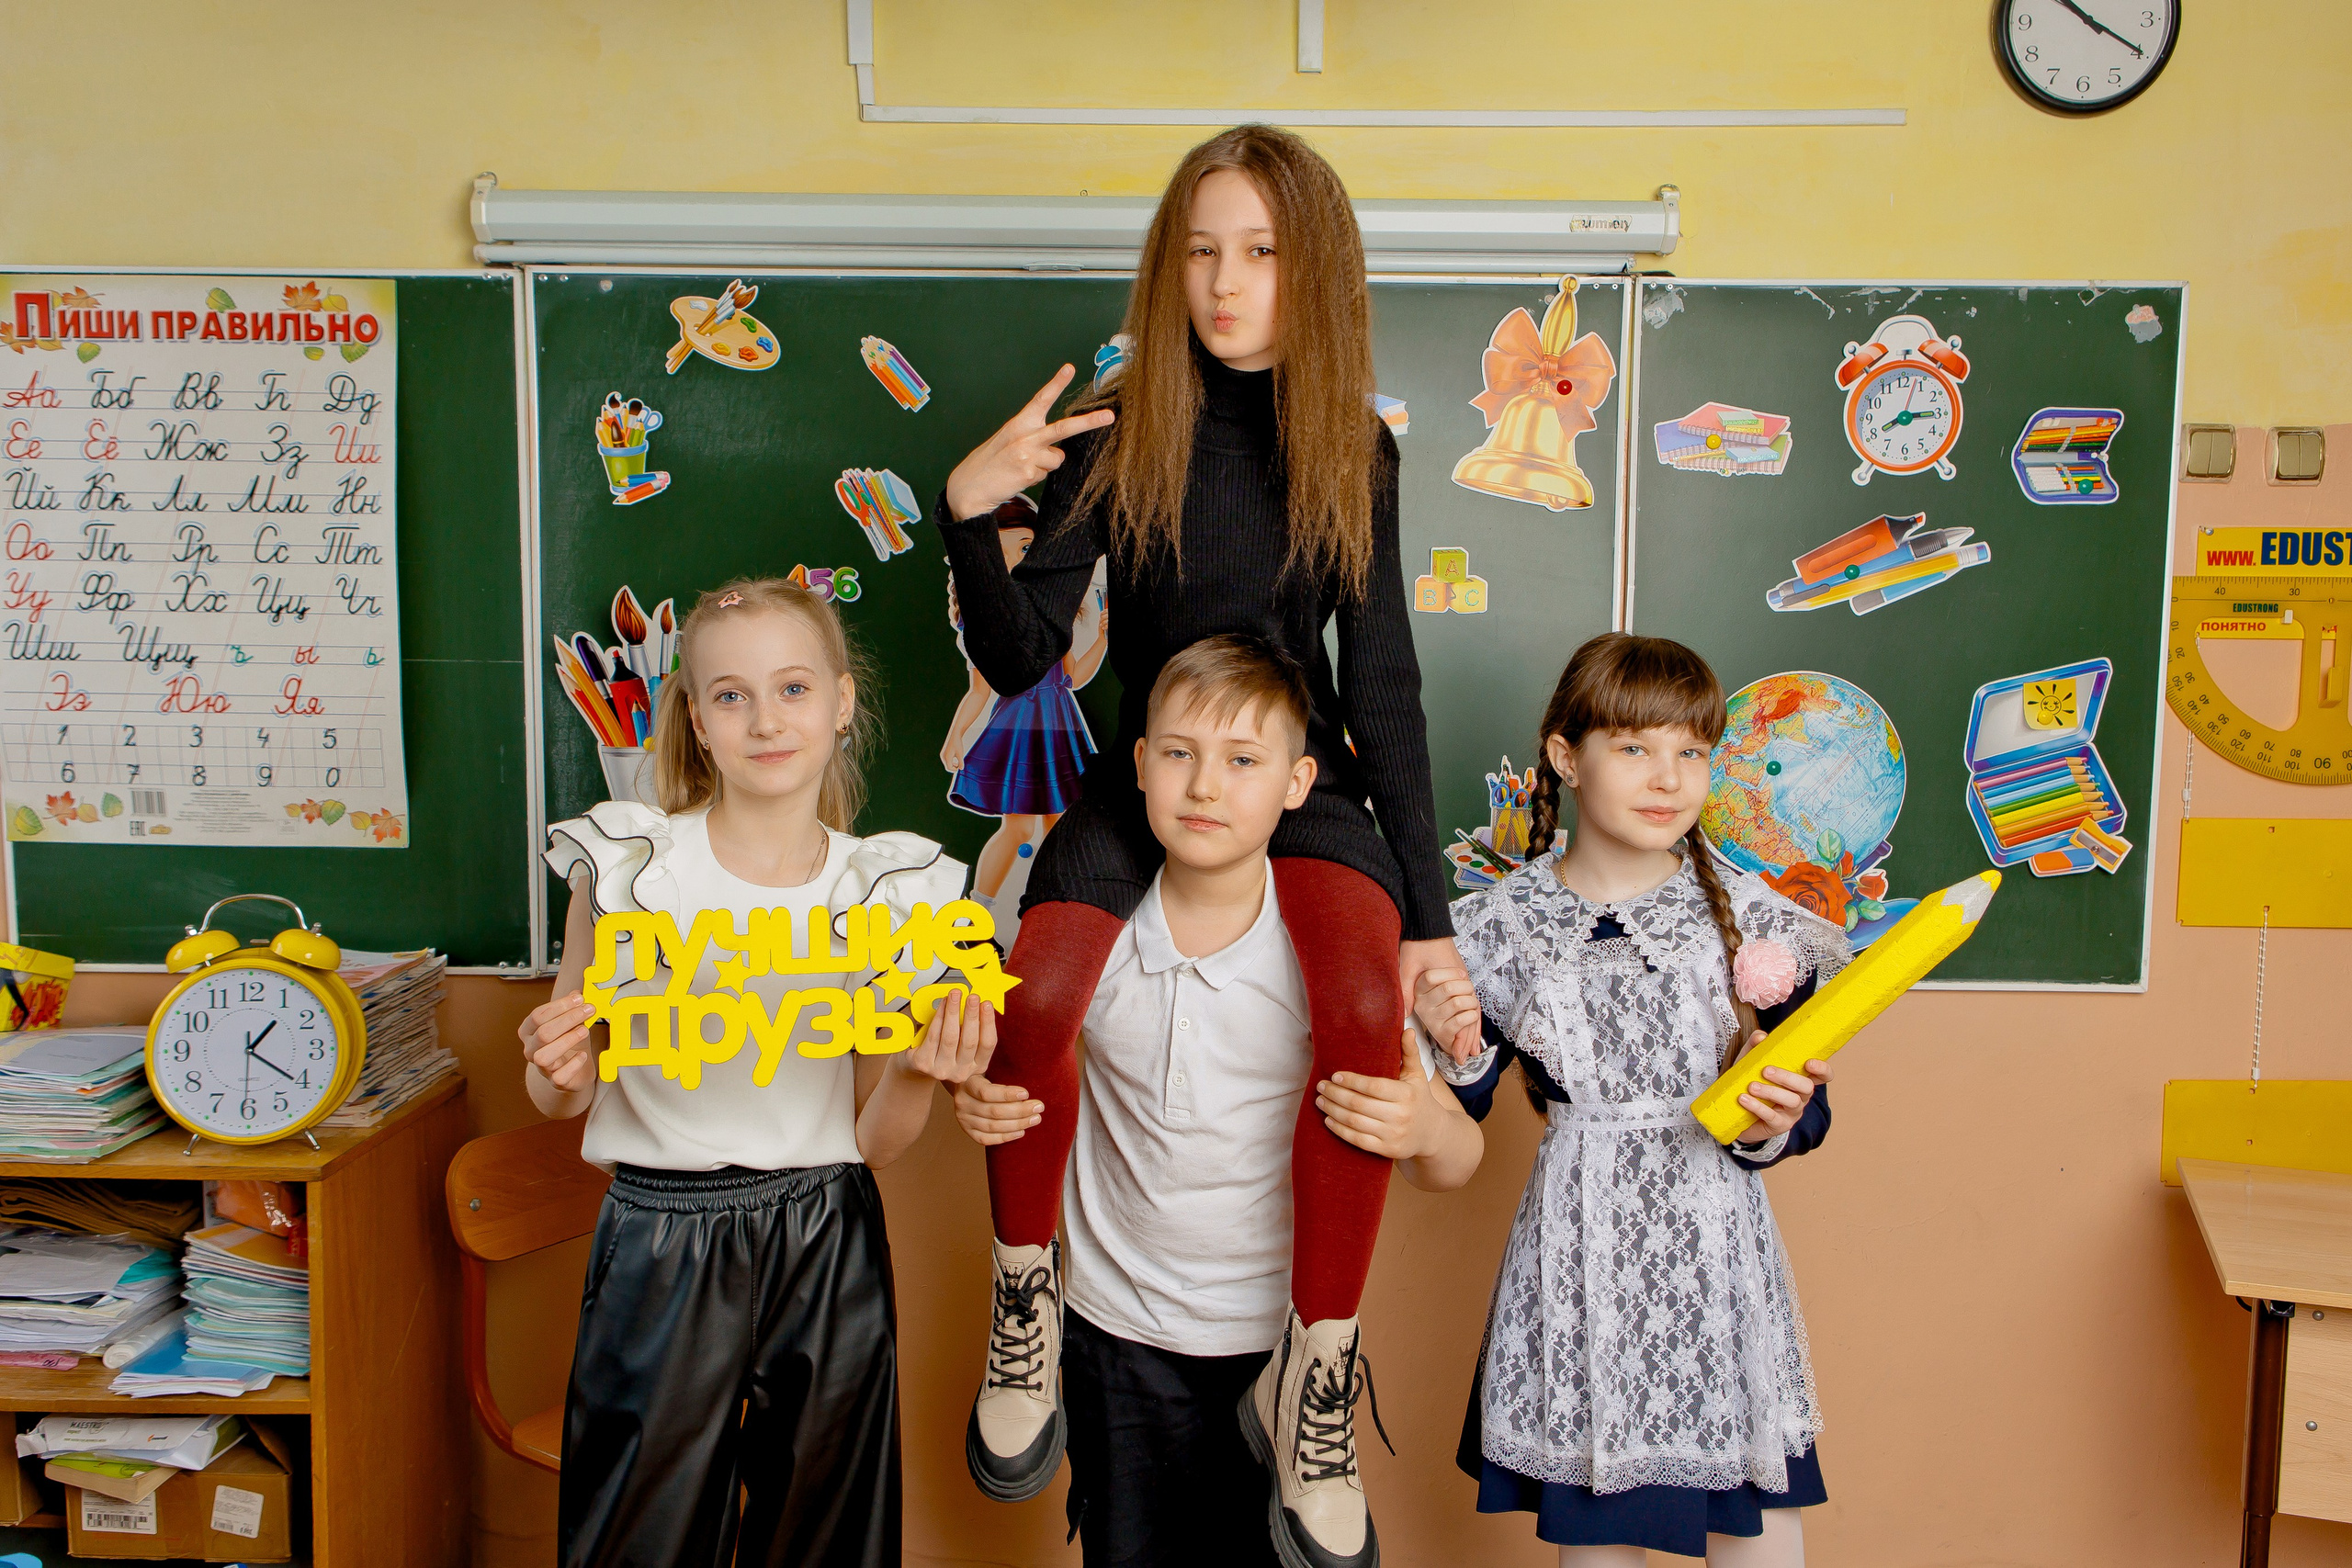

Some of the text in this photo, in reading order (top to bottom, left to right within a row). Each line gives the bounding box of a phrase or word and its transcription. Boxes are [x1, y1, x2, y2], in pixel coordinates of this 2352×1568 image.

[2018, 15, 2032, 30] 9
[2141, 11, 2154, 28] 3
[2025, 46, 2039, 62] 8
[2130, 44, 2143, 59] 4
[2047, 68, 2060, 85] 7
[2076, 75, 2089, 92] 6
[2108, 68, 2120, 84] 5
[1880, 382, 1893, 394] 11
[1896, 377, 1909, 388] 12
[1918, 380, 1924, 391] 1
[3, 370, 381, 424] Аа Бб Вв Гг Дд
[1868, 397, 1882, 409] 10
[1929, 391, 1937, 402] 2
[1866, 413, 1872, 424] 9
[1935, 408, 1941, 419] 3
[1871, 428, 1878, 439] 8
[1928, 424, 1937, 435] 4
[6, 419, 380, 479] Ее Ёё Жж Зз Ии
[1883, 439, 1891, 450] 7
[1902, 443, 1909, 455] 6
[1917, 438, 1924, 450] 5
[5, 467, 381, 514] Йй Кк Лл Мм Нн
[5, 524, 383, 575] Оо Пп Рр Сс Тт
[1444, 559, 1459, 577] A
[4, 572, 383, 624] Уу Фф Хх Цц Чч
[1423, 589, 1479, 606] B C
[2290, 588, 2301, 596] 30
[2233, 604, 2278, 613] EDUSTRONG
[2171, 621, 2179, 631] 10
[3, 624, 385, 671] Шш Щщ ъ ы ь
[2176, 647, 2185, 659] 20
[2172, 676, 2184, 691] 150
[2185, 672, 2195, 683] 30
[45, 673, 324, 715] Ээ Юю Яя
[2199, 694, 2210, 705] 40
[2188, 700, 2200, 715] 140
[2218, 714, 2229, 725] 50
[2207, 722, 2222, 735] 130
[2240, 729, 2251, 739] 60
[57, 725, 337, 749] 1 2 3 4 5
[2231, 739, 2245, 751] 120
[2264, 740, 2275, 751] 70
[2257, 751, 2272, 762] 110
[2290, 749, 2301, 758] 80
[2285, 761, 2301, 770] 100
[2314, 758, 2332, 769] 90
[62, 762, 340, 788] 6 7 8 9 0
[585, 899, 996, 1007] лучшие
[208, 988, 230, 1009] 11
[239, 982, 265, 1001] 12
[279, 988, 288, 1009] 1
[184, 1010, 209, 1032] 10
[300, 1010, 314, 1030] 2
[174, 1040, 190, 1062] 9
[309, 1039, 324, 1060] 3
[185, 1071, 202, 1093] 8
[294, 1069, 311, 1089] 4
[209, 1093, 225, 1113] 7
[273, 1091, 288, 1111] 5
[241, 1099, 256, 1120] 6
